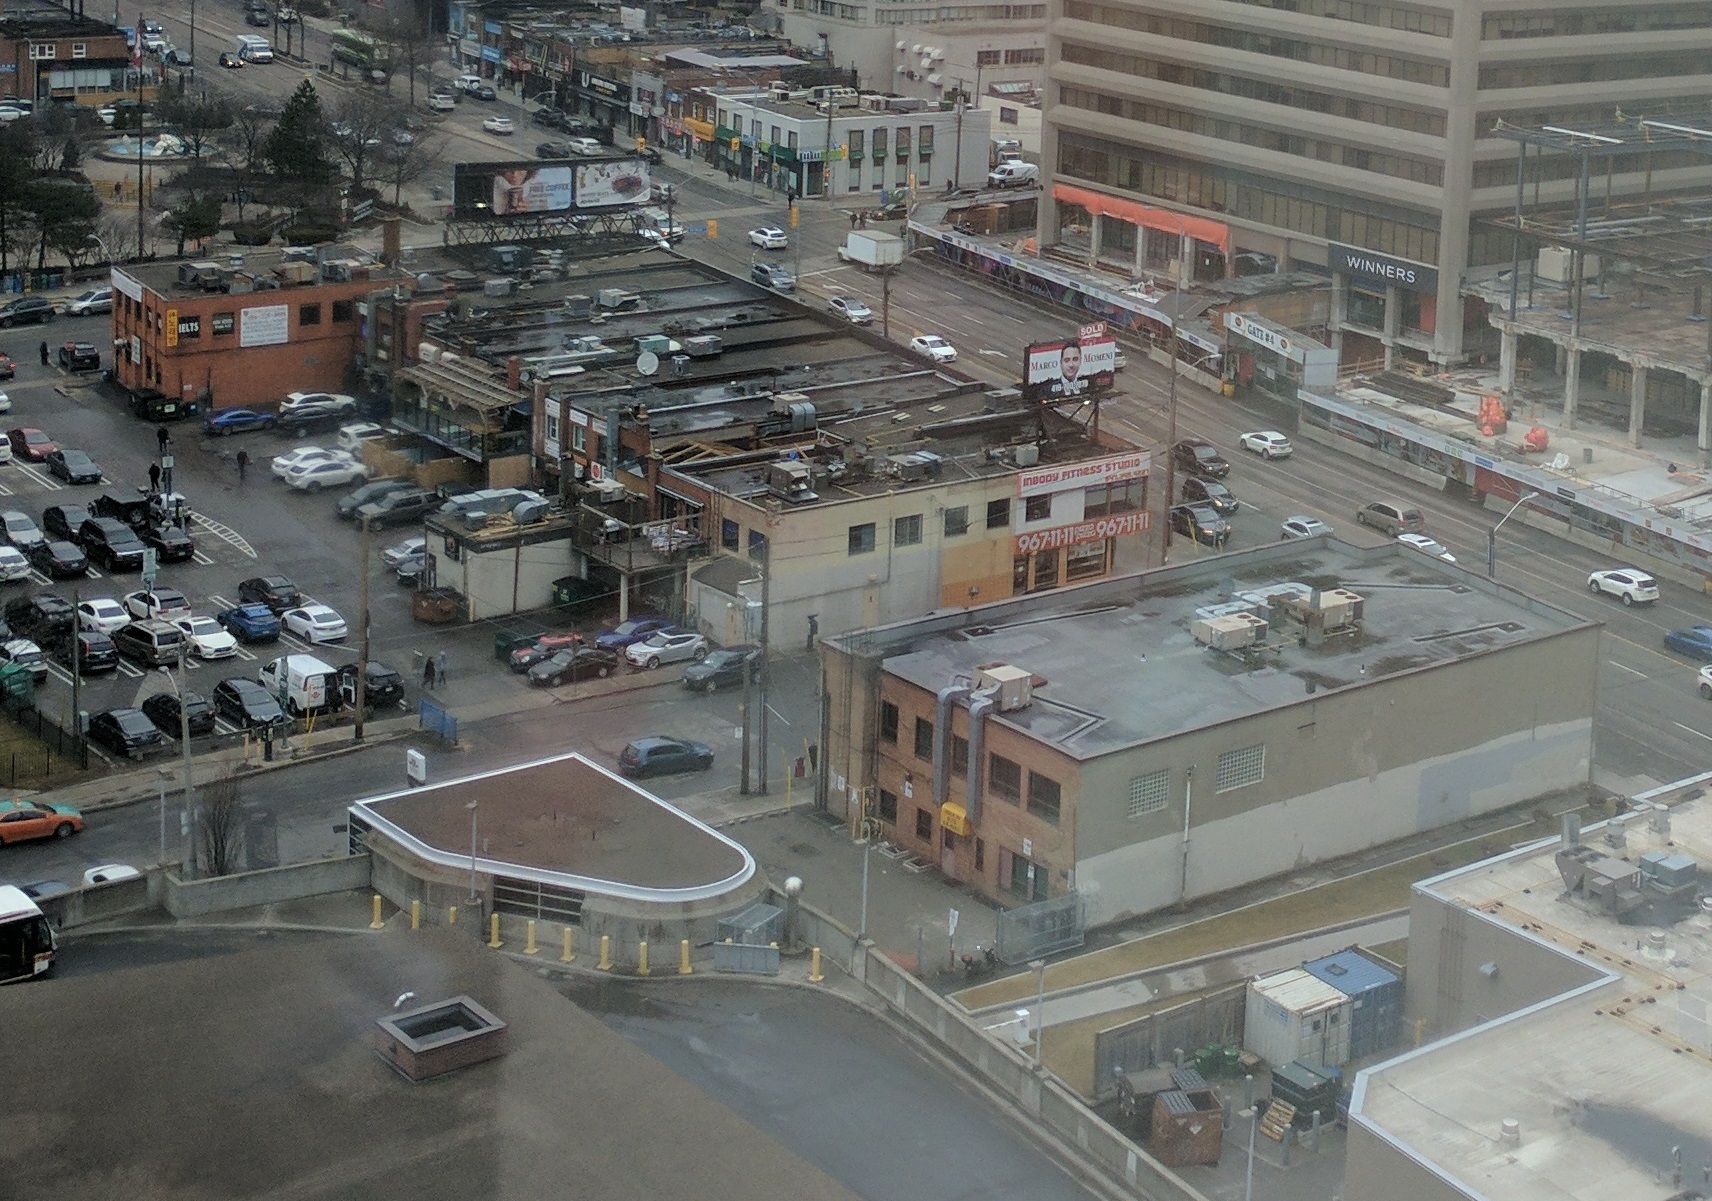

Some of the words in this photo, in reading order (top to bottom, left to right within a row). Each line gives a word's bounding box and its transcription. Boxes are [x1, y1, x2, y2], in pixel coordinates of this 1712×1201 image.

[1347, 255, 1416, 284] WINNERS
[178, 322, 199, 334] IELTS
[1080, 323, 1104, 336] SOLD
[1247, 323, 1265, 341] GATE
[1097, 513, 1149, 537] 967-11-11
[1018, 527, 1075, 553] 967-11-11
